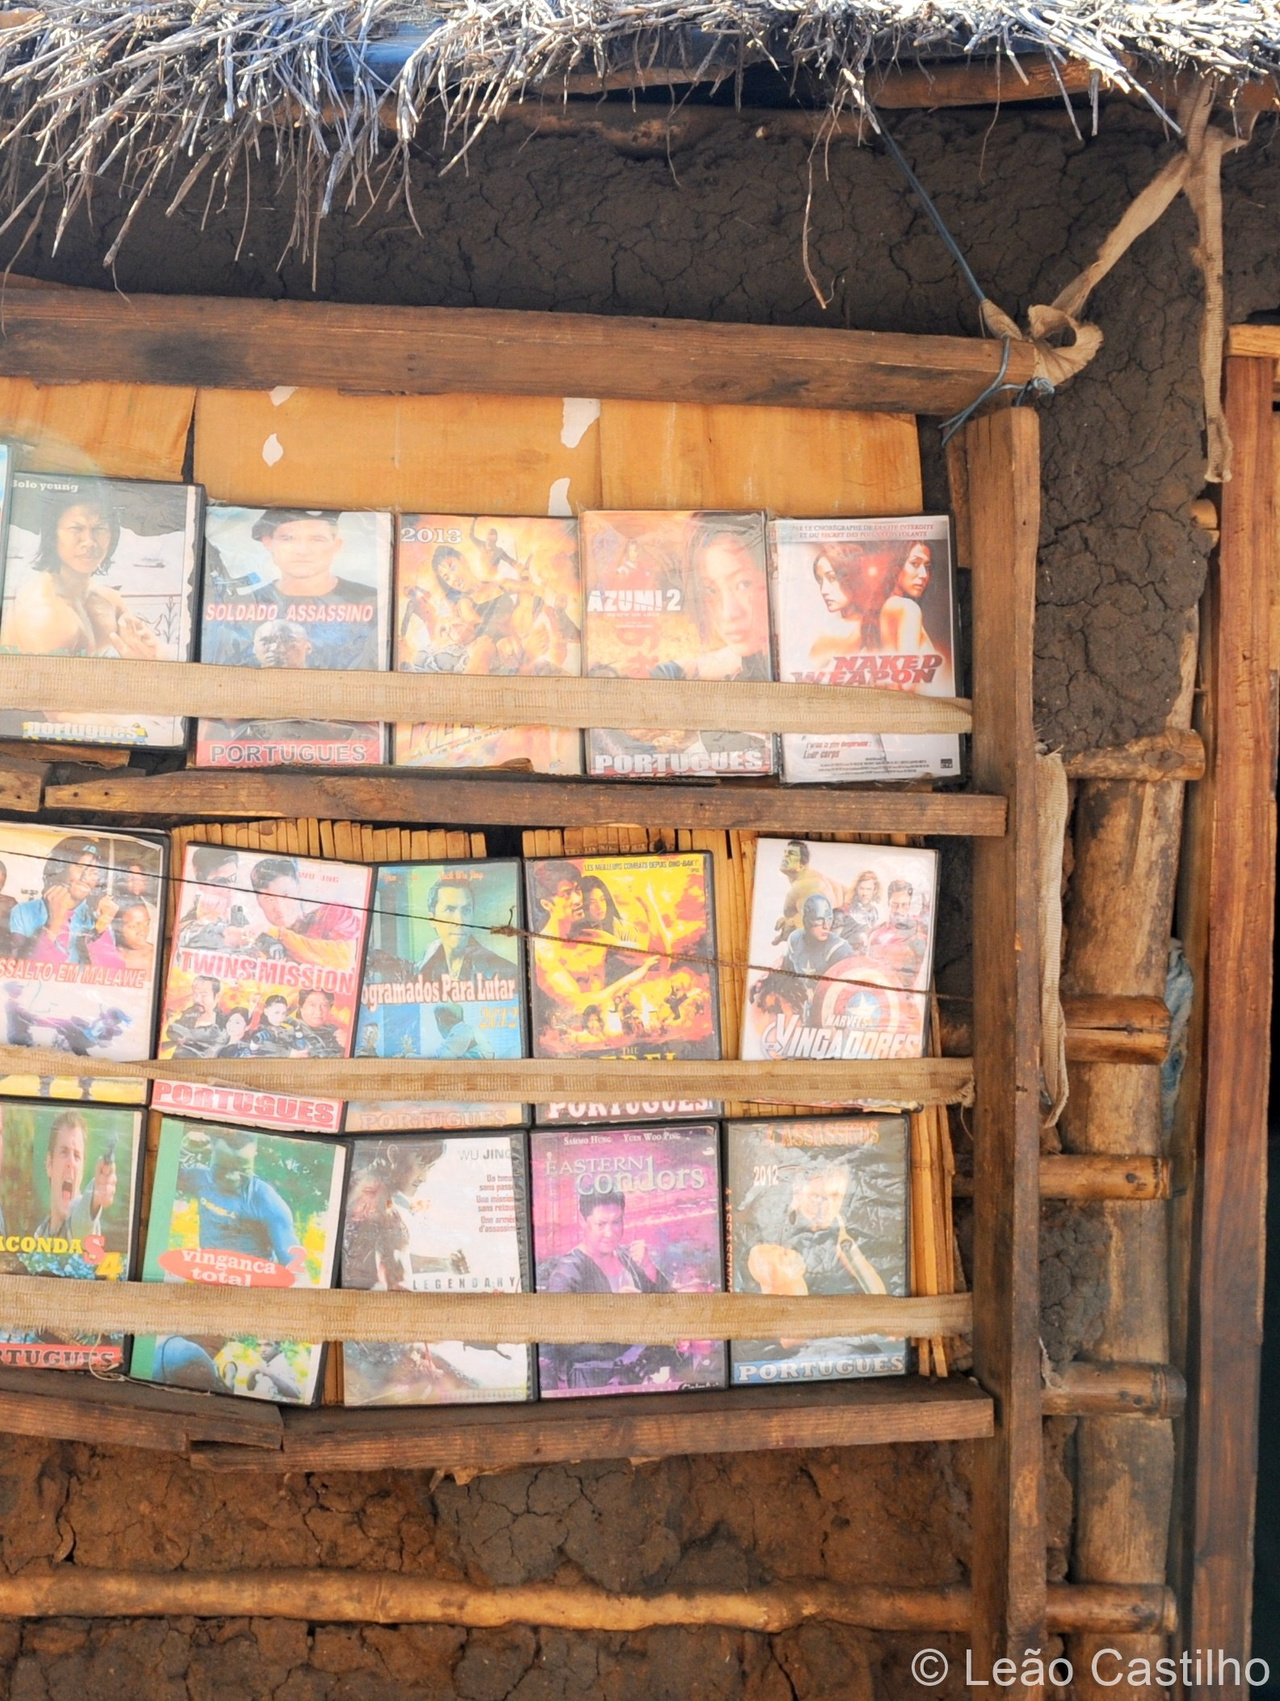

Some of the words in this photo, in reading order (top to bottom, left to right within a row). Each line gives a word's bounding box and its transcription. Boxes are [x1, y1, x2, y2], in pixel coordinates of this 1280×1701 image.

[40, 482, 79, 493] young
[400, 527, 463, 544] 2013
[587, 589, 663, 612] AZUMI
[666, 588, 682, 612] 2
[205, 603, 278, 623] SOLDADO
[286, 603, 374, 623] ASSASSINO
[833, 654, 943, 671] NAKED
[791, 668, 936, 686] WEAPON
[210, 743, 367, 764] PORTUGUES
[594, 749, 764, 774] PORTUGUES
[55, 962, 79, 983] EM
[81, 966, 147, 989] MALAWE
[180, 950, 254, 981] TWINS
[256, 959, 356, 995] MISSION
[440, 973, 475, 1002] Para
[476, 973, 516, 1001] Lutar
[776, 1013, 923, 1060] VINGADORES
[154, 1081, 335, 1125] PORTUGUES
[360, 1109, 506, 1130] PORTUGUES
[460, 1150, 479, 1160] WU
[546, 1155, 644, 1175] EASTERN
[753, 1165, 778, 1187] 2012
[95, 1252, 124, 1282] 4
[182, 1248, 277, 1275] vinganca
[286, 1245, 308, 1276] 2
[191, 1267, 253, 1288] total
[413, 1276, 516, 1291] LEGENDARY
[739, 1355, 905, 1381] PORTUGUES
